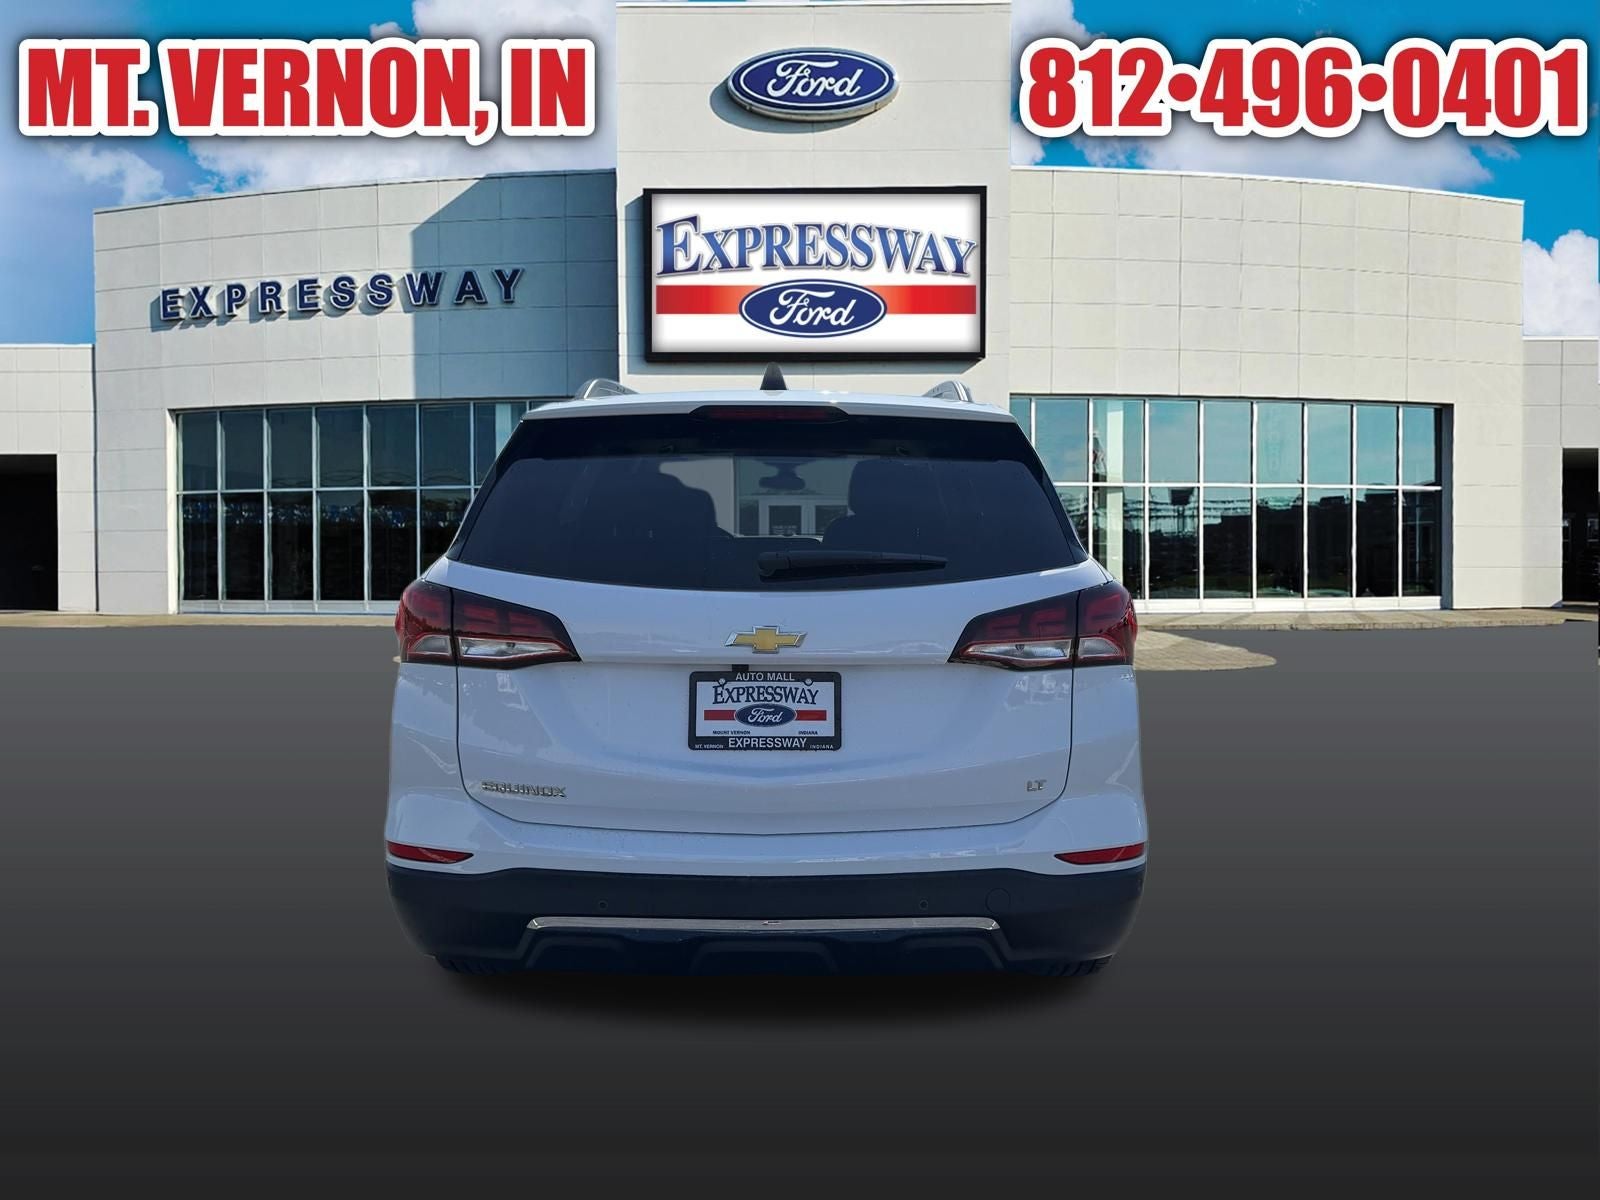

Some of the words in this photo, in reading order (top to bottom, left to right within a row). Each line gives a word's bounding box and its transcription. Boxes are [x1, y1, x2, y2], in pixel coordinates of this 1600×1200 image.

[766, 58, 864, 98] Ford
[160, 267, 525, 322] EXPRESSWAY
[769, 287, 856, 327] Ford
[735, 672, 764, 681] AUTO
[767, 672, 795, 681] MALL
[748, 707, 782, 723] Ford
[728, 737, 807, 748] EXPRESSWAY
